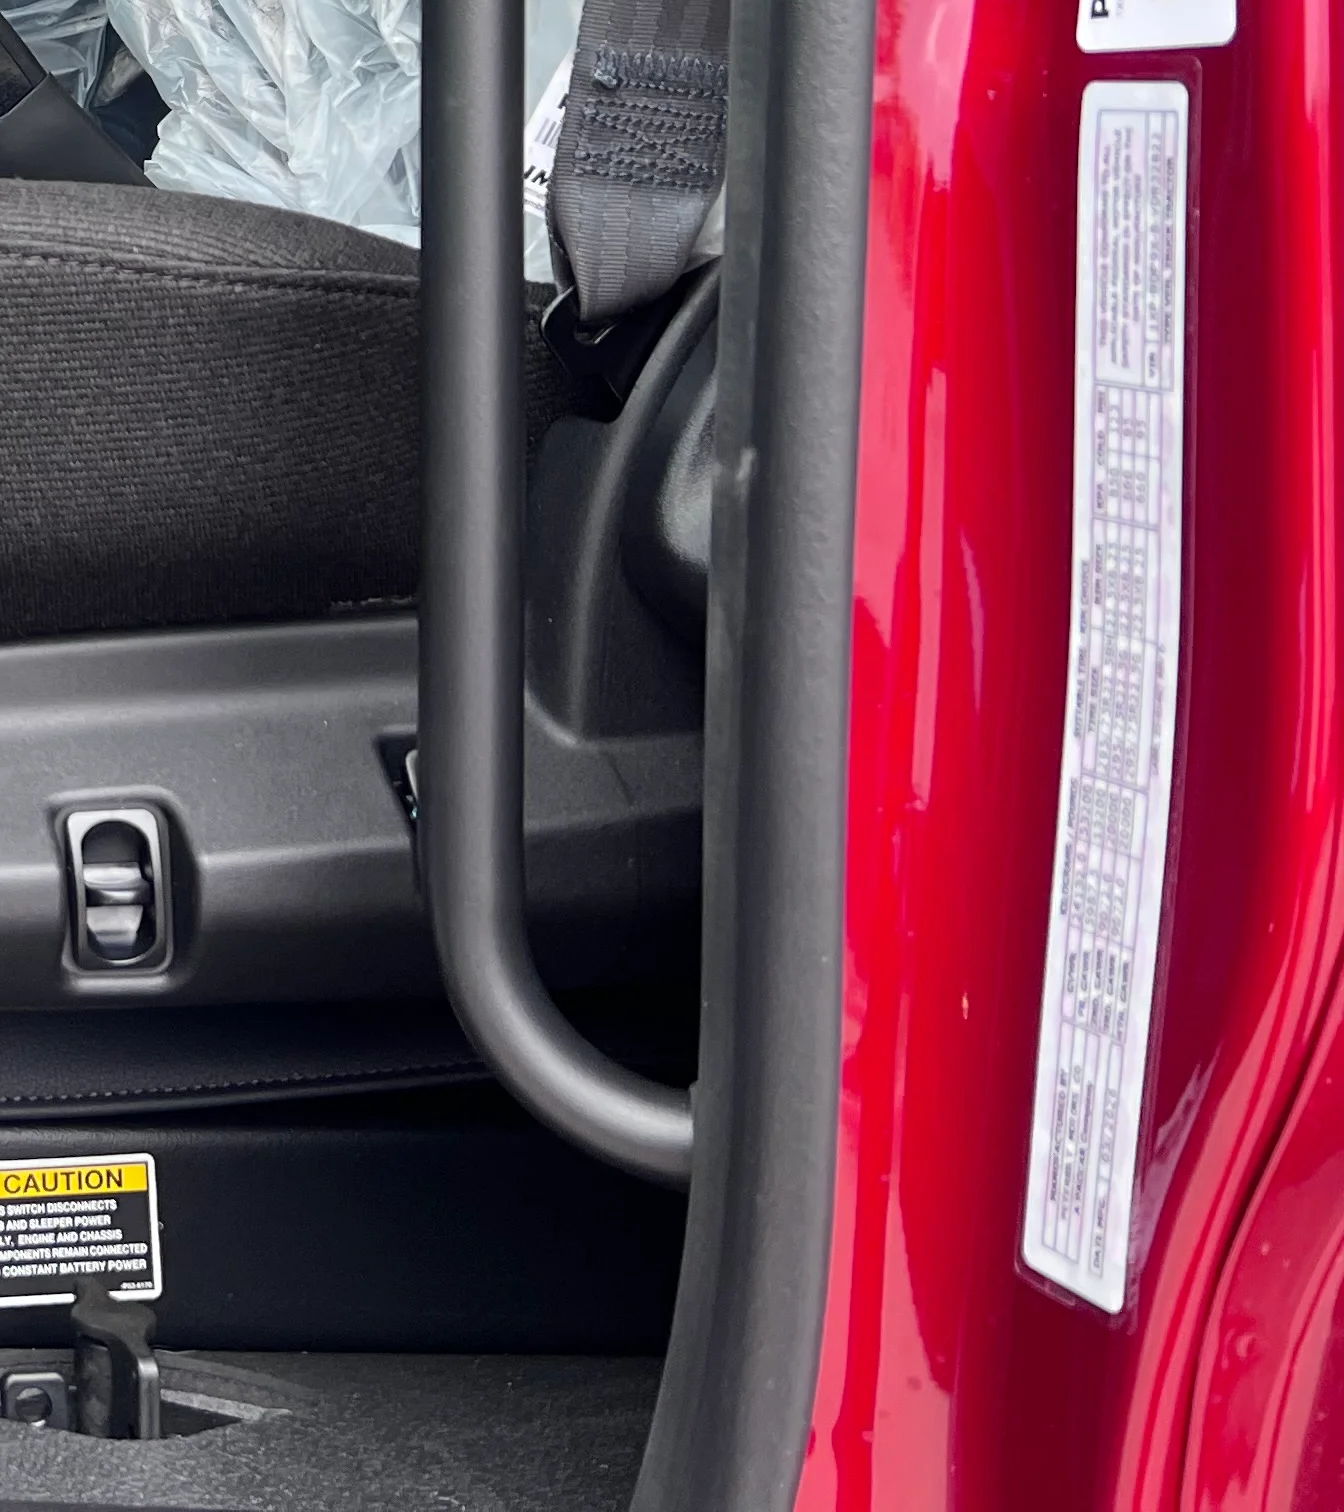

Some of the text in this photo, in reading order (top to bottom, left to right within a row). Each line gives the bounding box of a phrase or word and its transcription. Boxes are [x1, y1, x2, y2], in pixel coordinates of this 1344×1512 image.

[3, 1168, 123, 1194] CAUTION
[6, 1202, 46, 1216] SWITCH
[46, 1199, 118, 1214] DISCONNECTS
[5, 1218, 28, 1231] AND
[28, 1216, 73, 1230] SLEEPER
[74, 1215, 112, 1228] POWER
[18, 1232, 56, 1246] ENGINE
[56, 1231, 78, 1244] AND
[79, 1229, 123, 1242] CHASSIS
[51, 1245, 89, 1259] REMAIN
[89, 1243, 148, 1257] CONNECTED
[2, 1263, 58, 1277] CONSTANT
[59, 1261, 107, 1275] BATTERY
[107, 1258, 147, 1272] POWER
